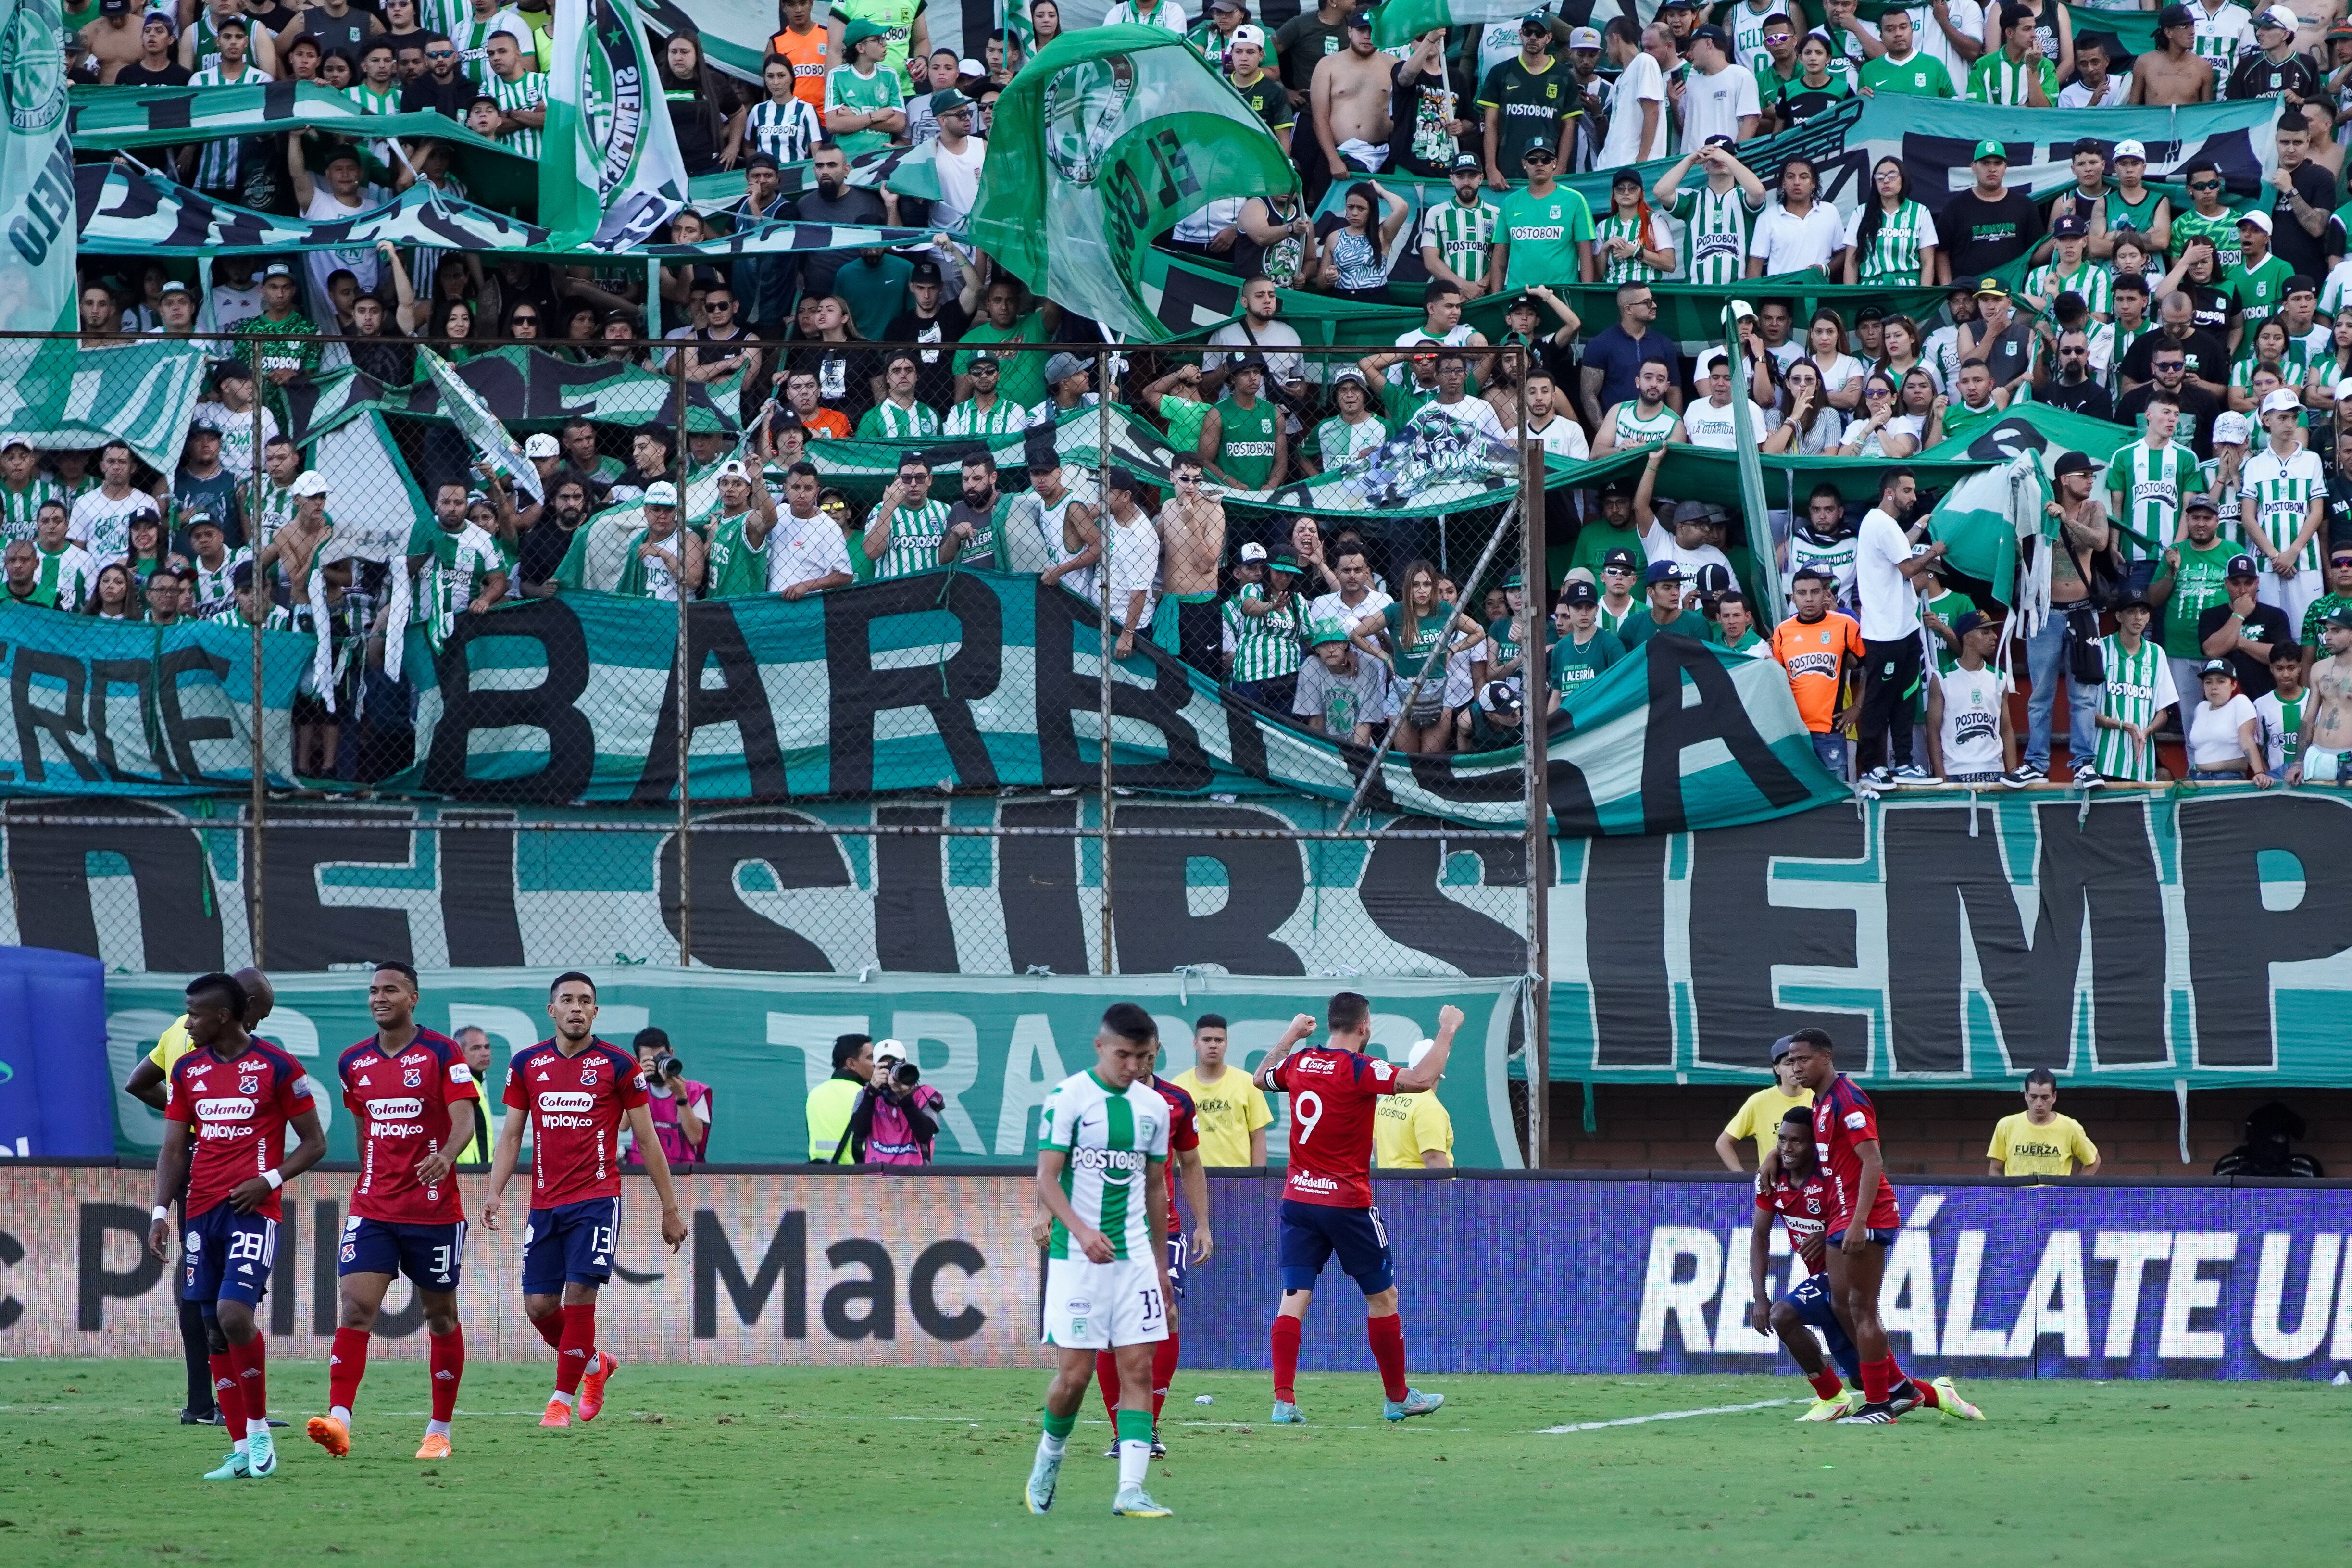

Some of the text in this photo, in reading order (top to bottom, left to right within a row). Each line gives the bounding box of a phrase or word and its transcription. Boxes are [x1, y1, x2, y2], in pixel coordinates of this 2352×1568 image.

[884, 26, 909, 41] OBON
[1739, 28, 1764, 51] CELT
[794, 65, 823, 76] STOBO
[1506, 103, 1555, 119] POSTOBON
[759, 125, 796, 135] OSTOBON
[1511, 227, 1560, 239] POSTOBON
[1877, 227, 1912, 238] STOBON
[1697, 234, 1738, 249] POSTOBON
[2196, 310, 2226, 324] TOBON
[2243, 306, 2269, 320] TOBON
[261, 356, 301, 370] STOBON
[1227, 441, 1275, 456] POSTOBON
[2134, 482, 2178, 500] POSTOBON
[2217, 503, 2241, 515] OSTOB
[1789, 654, 1837, 670] POSTOBON
[1567, 666, 1595, 681] ALEGRÍA
[238, 1059, 268, 1074] Pilsen
[352, 1055, 378, 1070] Pilsen
[400, 1053, 428, 1068] Pilsen
[531, 1054, 555, 1068] Pilsen
[583, 1056, 609, 1069] Pilsen
[187, 1064, 212, 1078] Pilsen
[197, 1099, 253, 1117] Colanta
[539, 1096, 591, 1108] Colanta
[1196, 1099, 1232, 1111] UERZA
[1383, 1095, 1412, 1107] APOYO
[367, 1102, 420, 1116] Colanta
[1377, 1107, 1407, 1121] LOGÍSTICO
[542, 1113, 593, 1130] Wplay.co
[1296, 1091, 1323, 1144] 9
[200, 1122, 253, 1141] Wplay.co
[370, 1121, 424, 1139] Wplay.co
[2014, 1144, 2060, 1154] FUERZA
[1071, 1146, 1147, 1172] POSTOBO
[1290, 1174, 1339, 1190] Medellín
[229, 1230, 263, 1261] 28
[591, 1225, 612, 1254] 13
[694, 1209, 987, 1341] Mac
[1635, 1194, 2238, 1359] REÁLATE
[1799, 1283, 1822, 1299] 27
